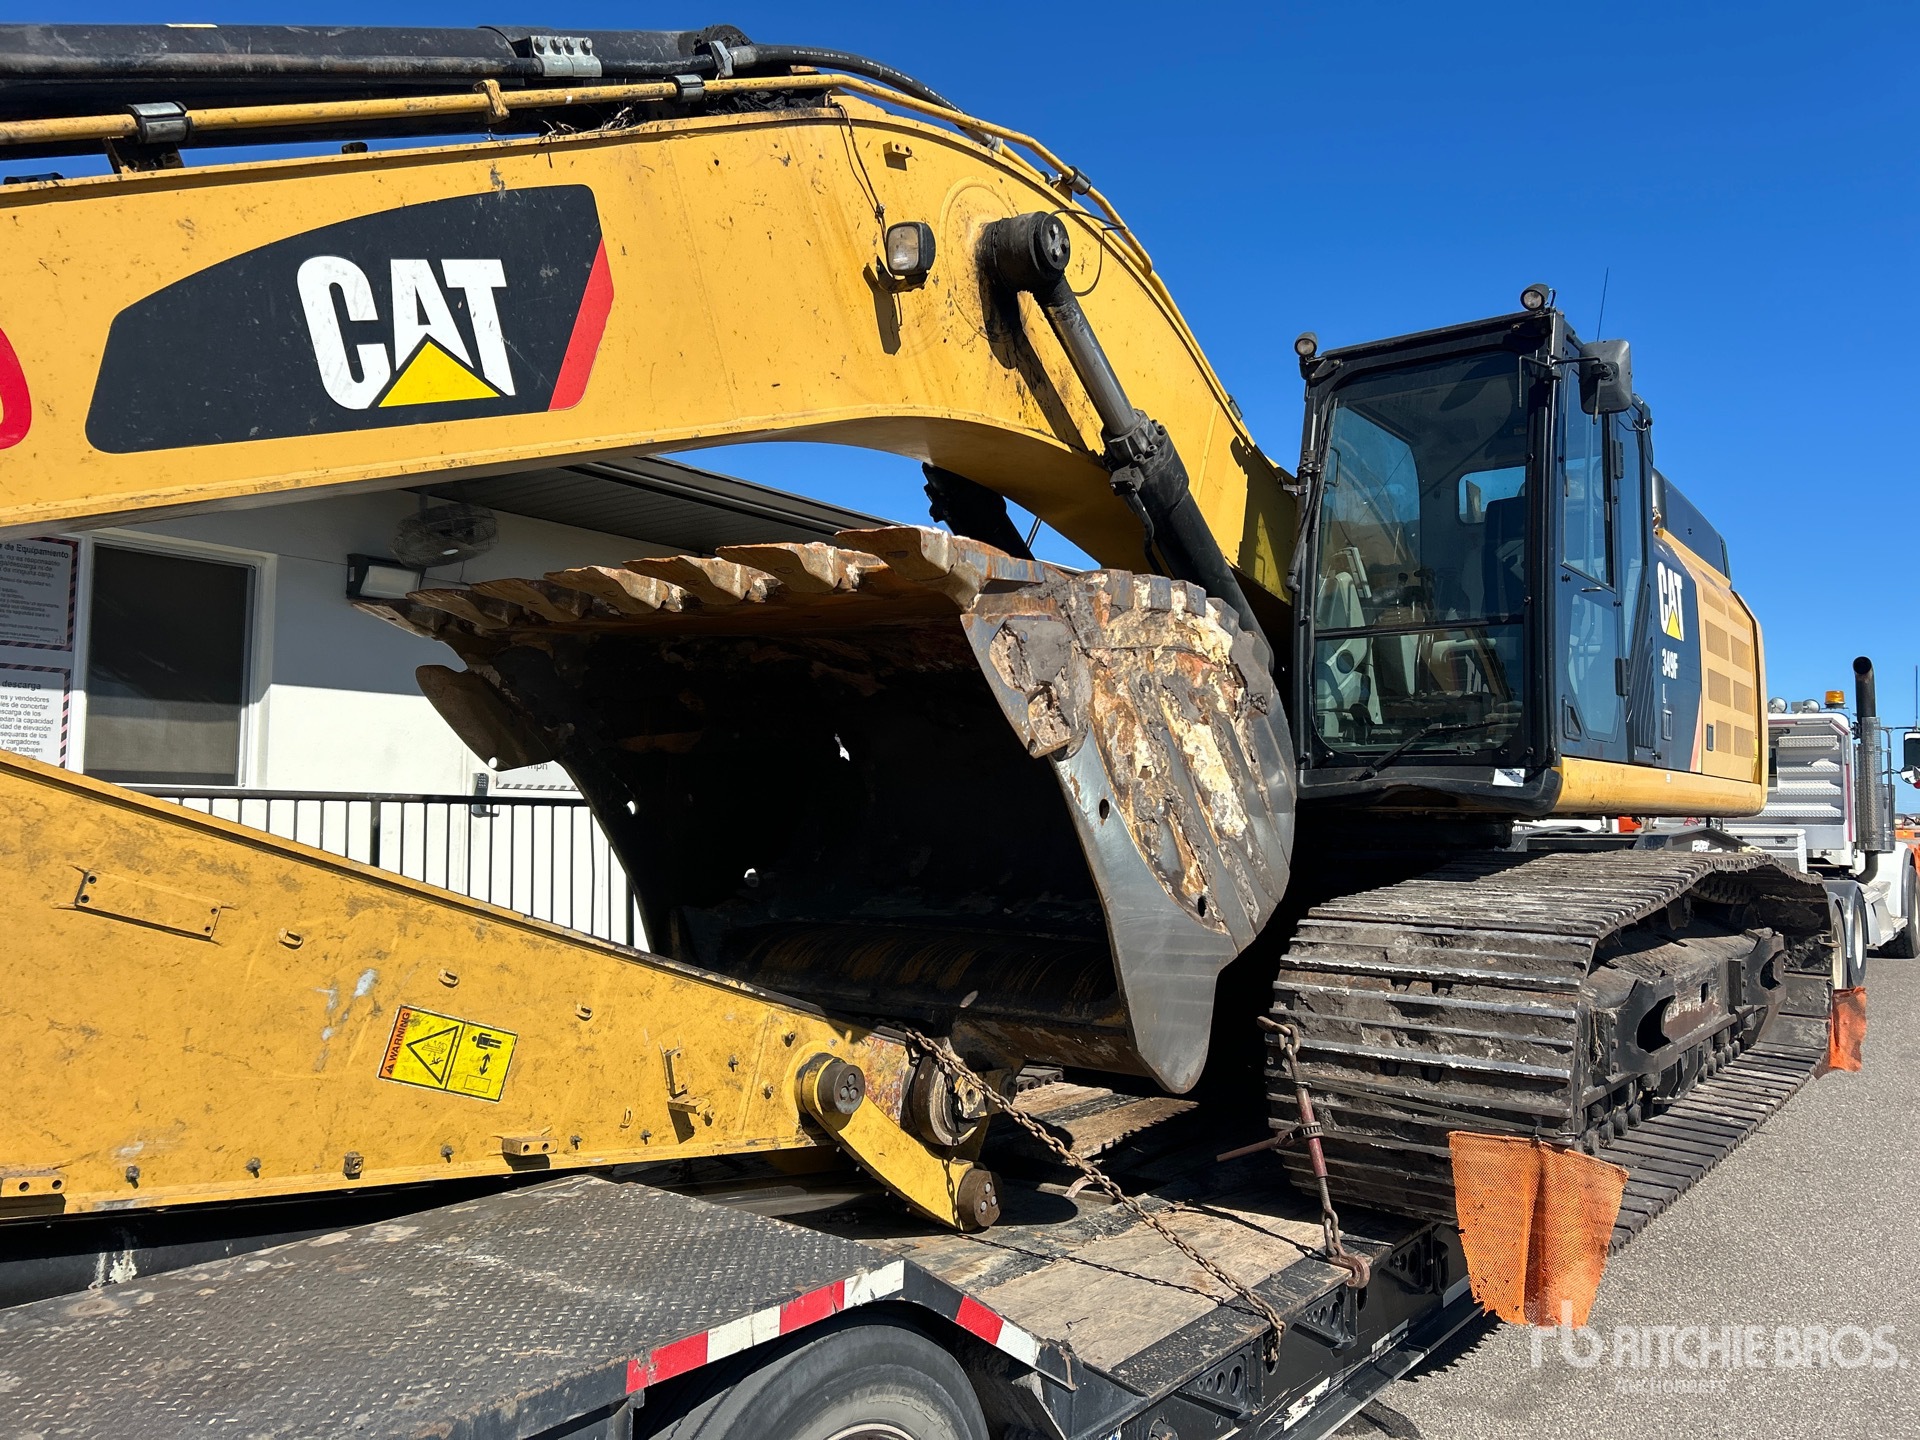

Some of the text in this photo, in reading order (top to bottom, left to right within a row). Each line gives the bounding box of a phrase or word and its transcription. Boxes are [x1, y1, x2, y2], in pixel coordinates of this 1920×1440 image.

[297, 255, 515, 411] CAT
[4, 543, 15, 552] de
[16, 544, 69, 559] Equipamiento
[1657, 561, 1685, 642] CAT
[1661, 648, 1678, 680] 349F
[2, 680, 41, 691] descarga
[15, 695, 49, 703] vendedores
[19, 746, 43, 754] trabajen
[389, 1012, 410, 1061] WARNING
